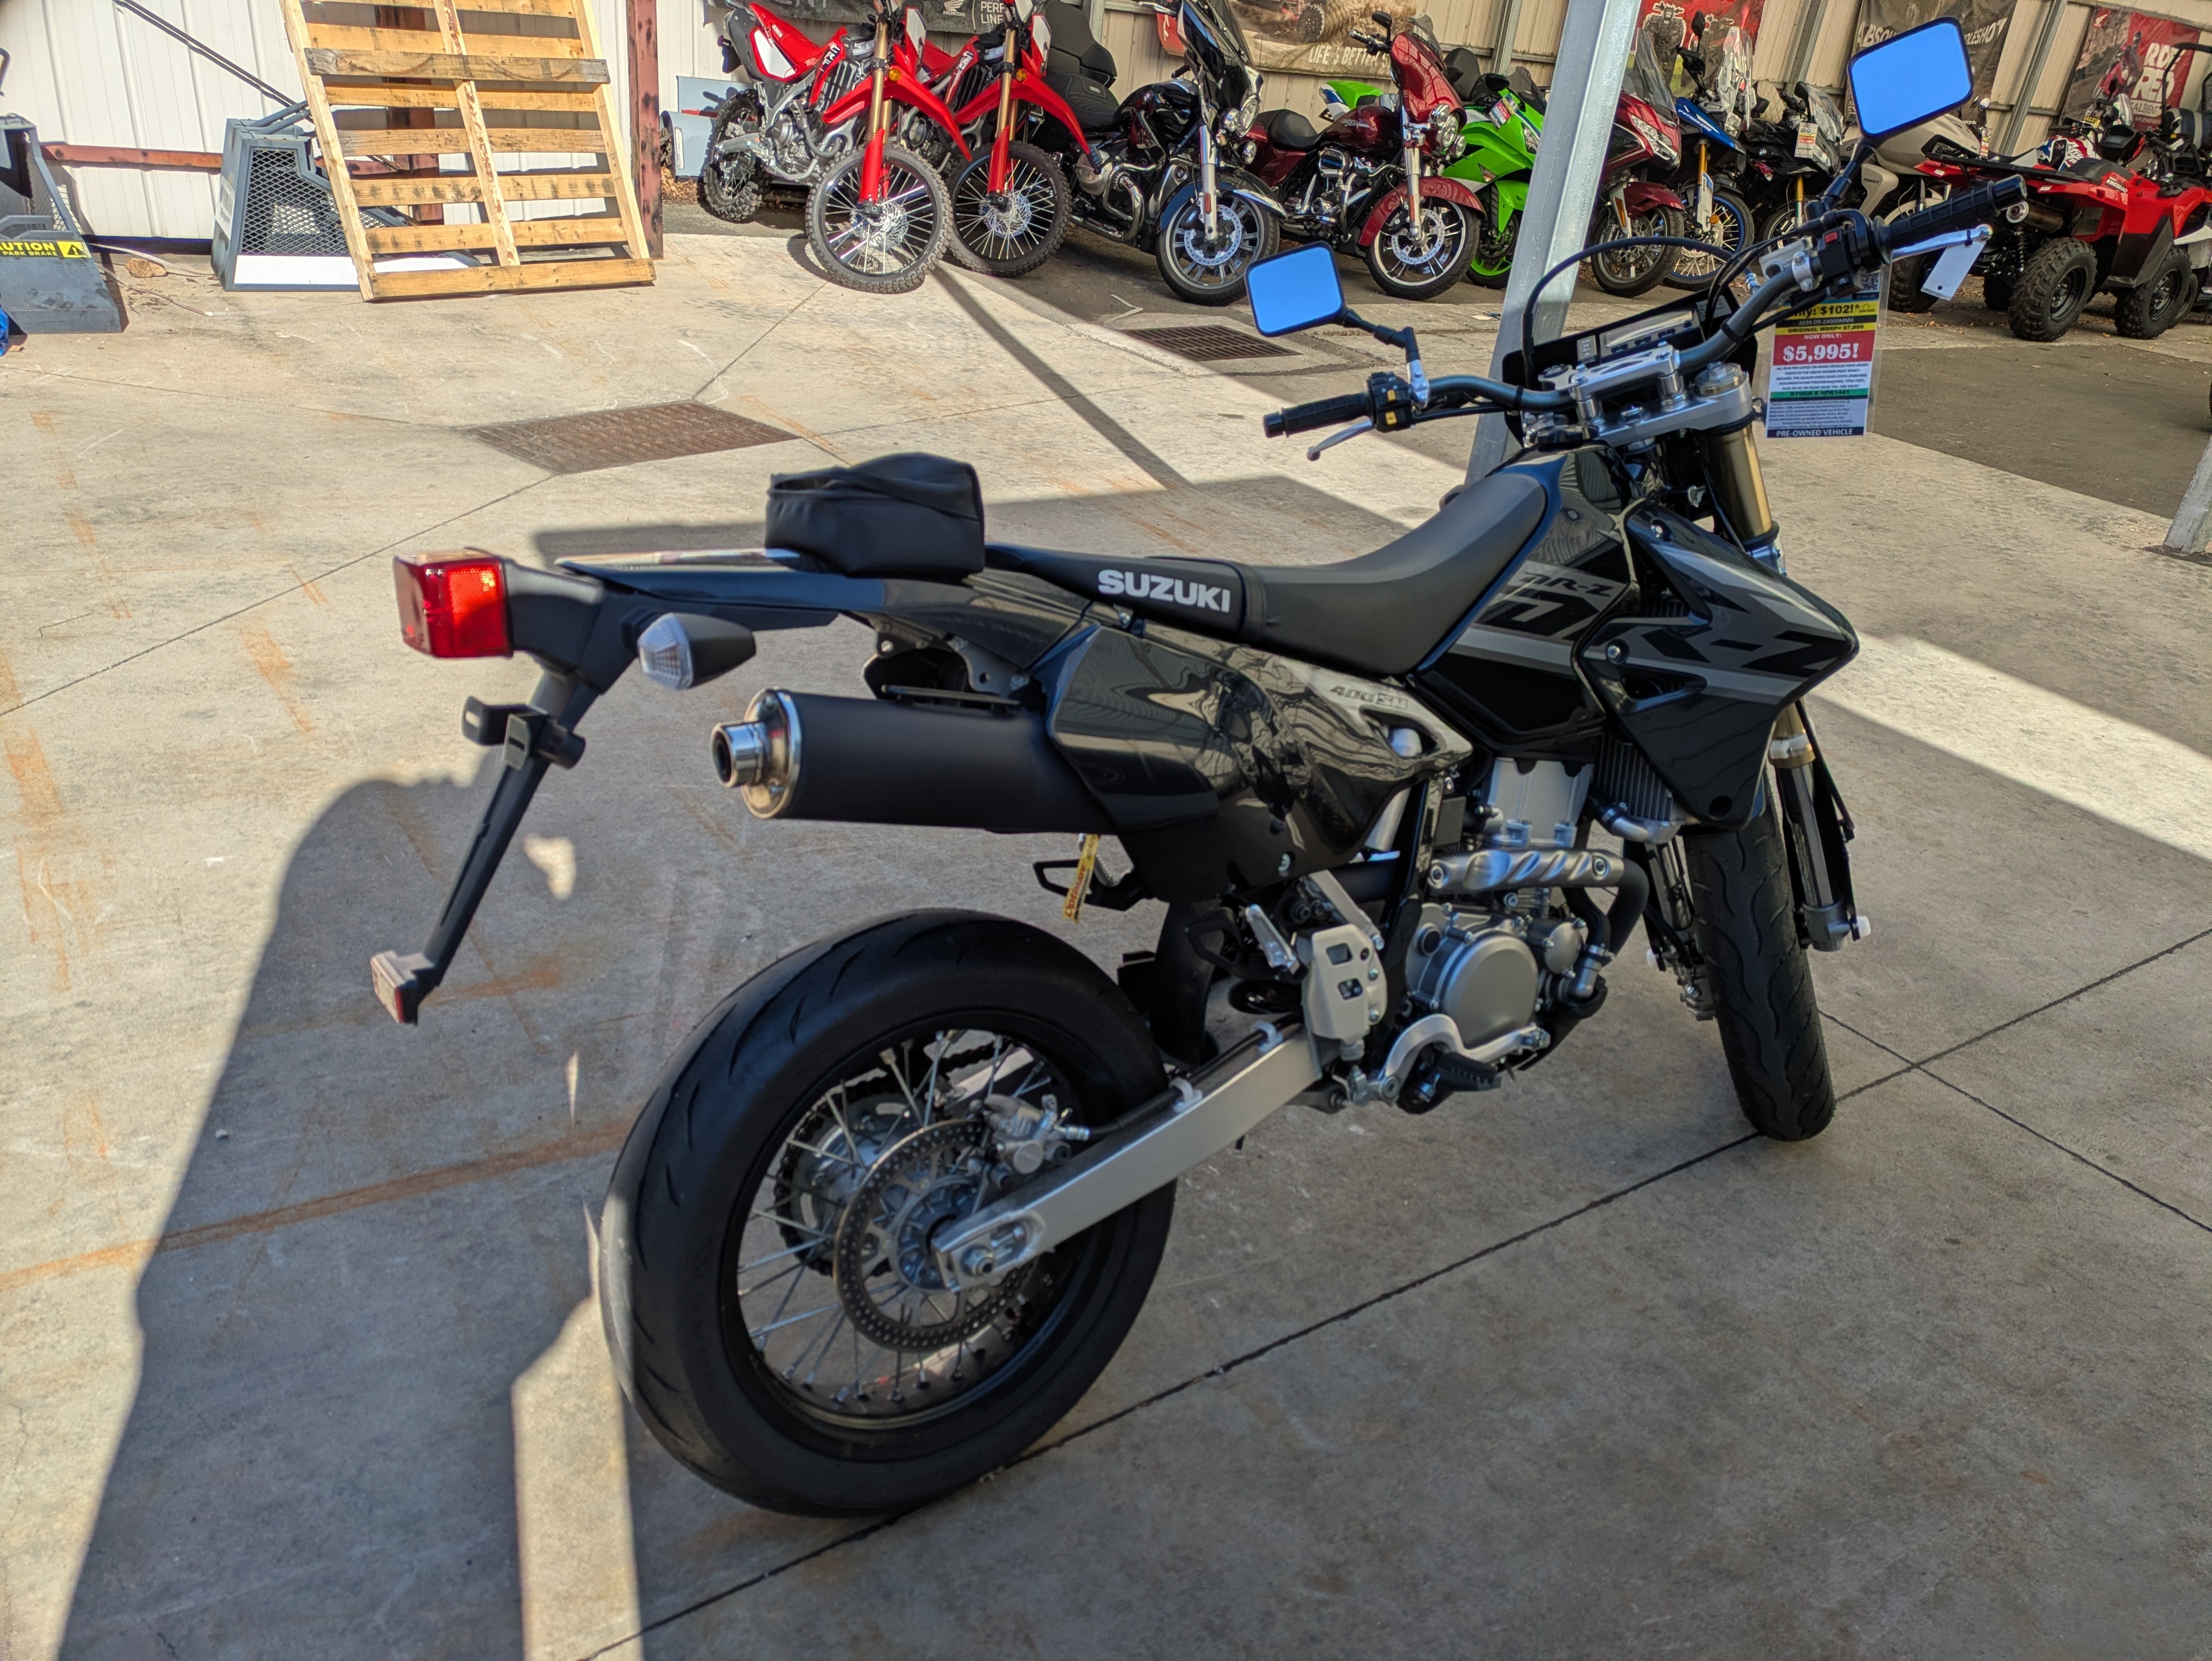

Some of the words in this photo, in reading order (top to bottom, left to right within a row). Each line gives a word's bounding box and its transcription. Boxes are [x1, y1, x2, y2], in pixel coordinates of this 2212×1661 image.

[771, 24, 783, 38] HONDA
[821, 41, 840, 66] CRF
[1308, 44, 1332, 65] LIFE
[2131, 66, 2175, 102] RED
[1783, 343, 1859, 363] $5,995!
[1098, 569, 1231, 613] SUZUKI
